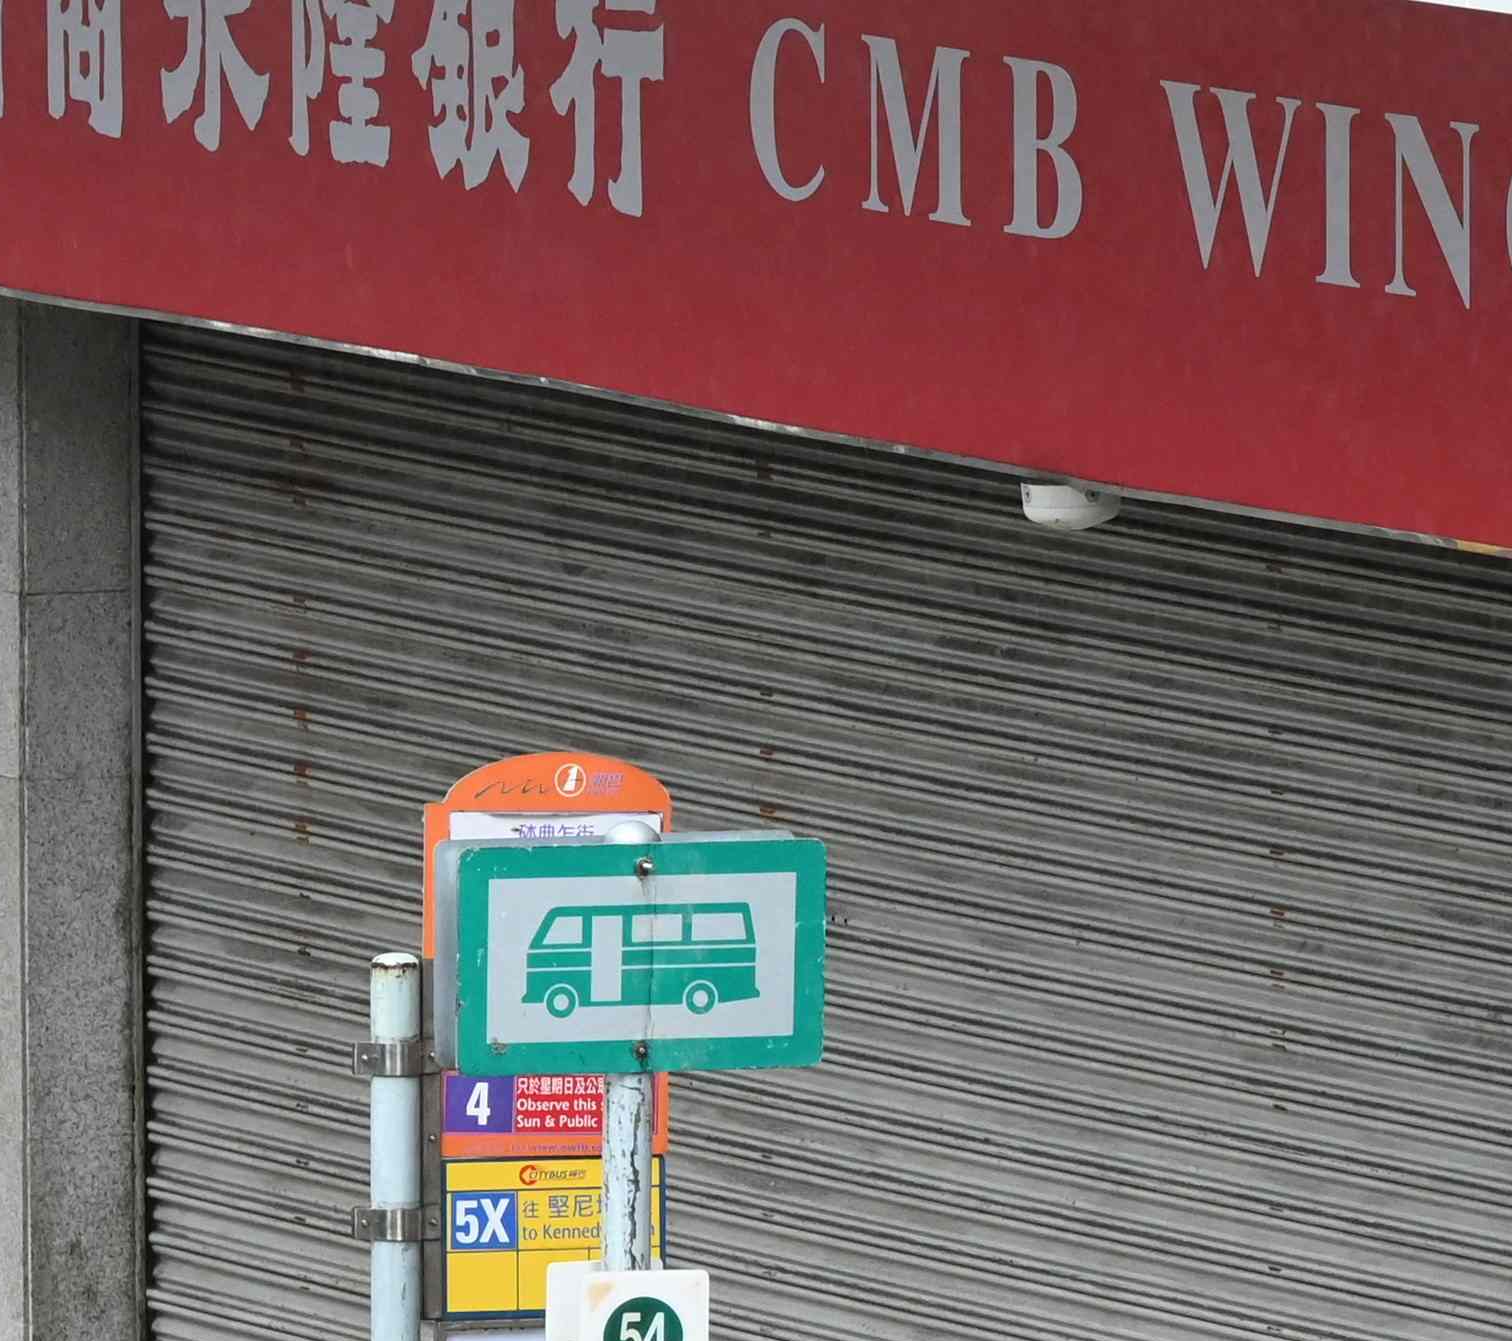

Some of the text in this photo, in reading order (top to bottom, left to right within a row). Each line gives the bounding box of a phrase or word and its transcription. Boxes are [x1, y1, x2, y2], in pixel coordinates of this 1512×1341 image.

[746, 15, 1085, 242] CMB
[465, 1082, 491, 1126] 4
[517, 1098, 597, 1112] Observe this
[516, 1114, 598, 1128] Sun & Public
[522, 1201, 539, 1219] 往
[455, 1198, 511, 1244] 5X
[521, 1228, 537, 1241] to
